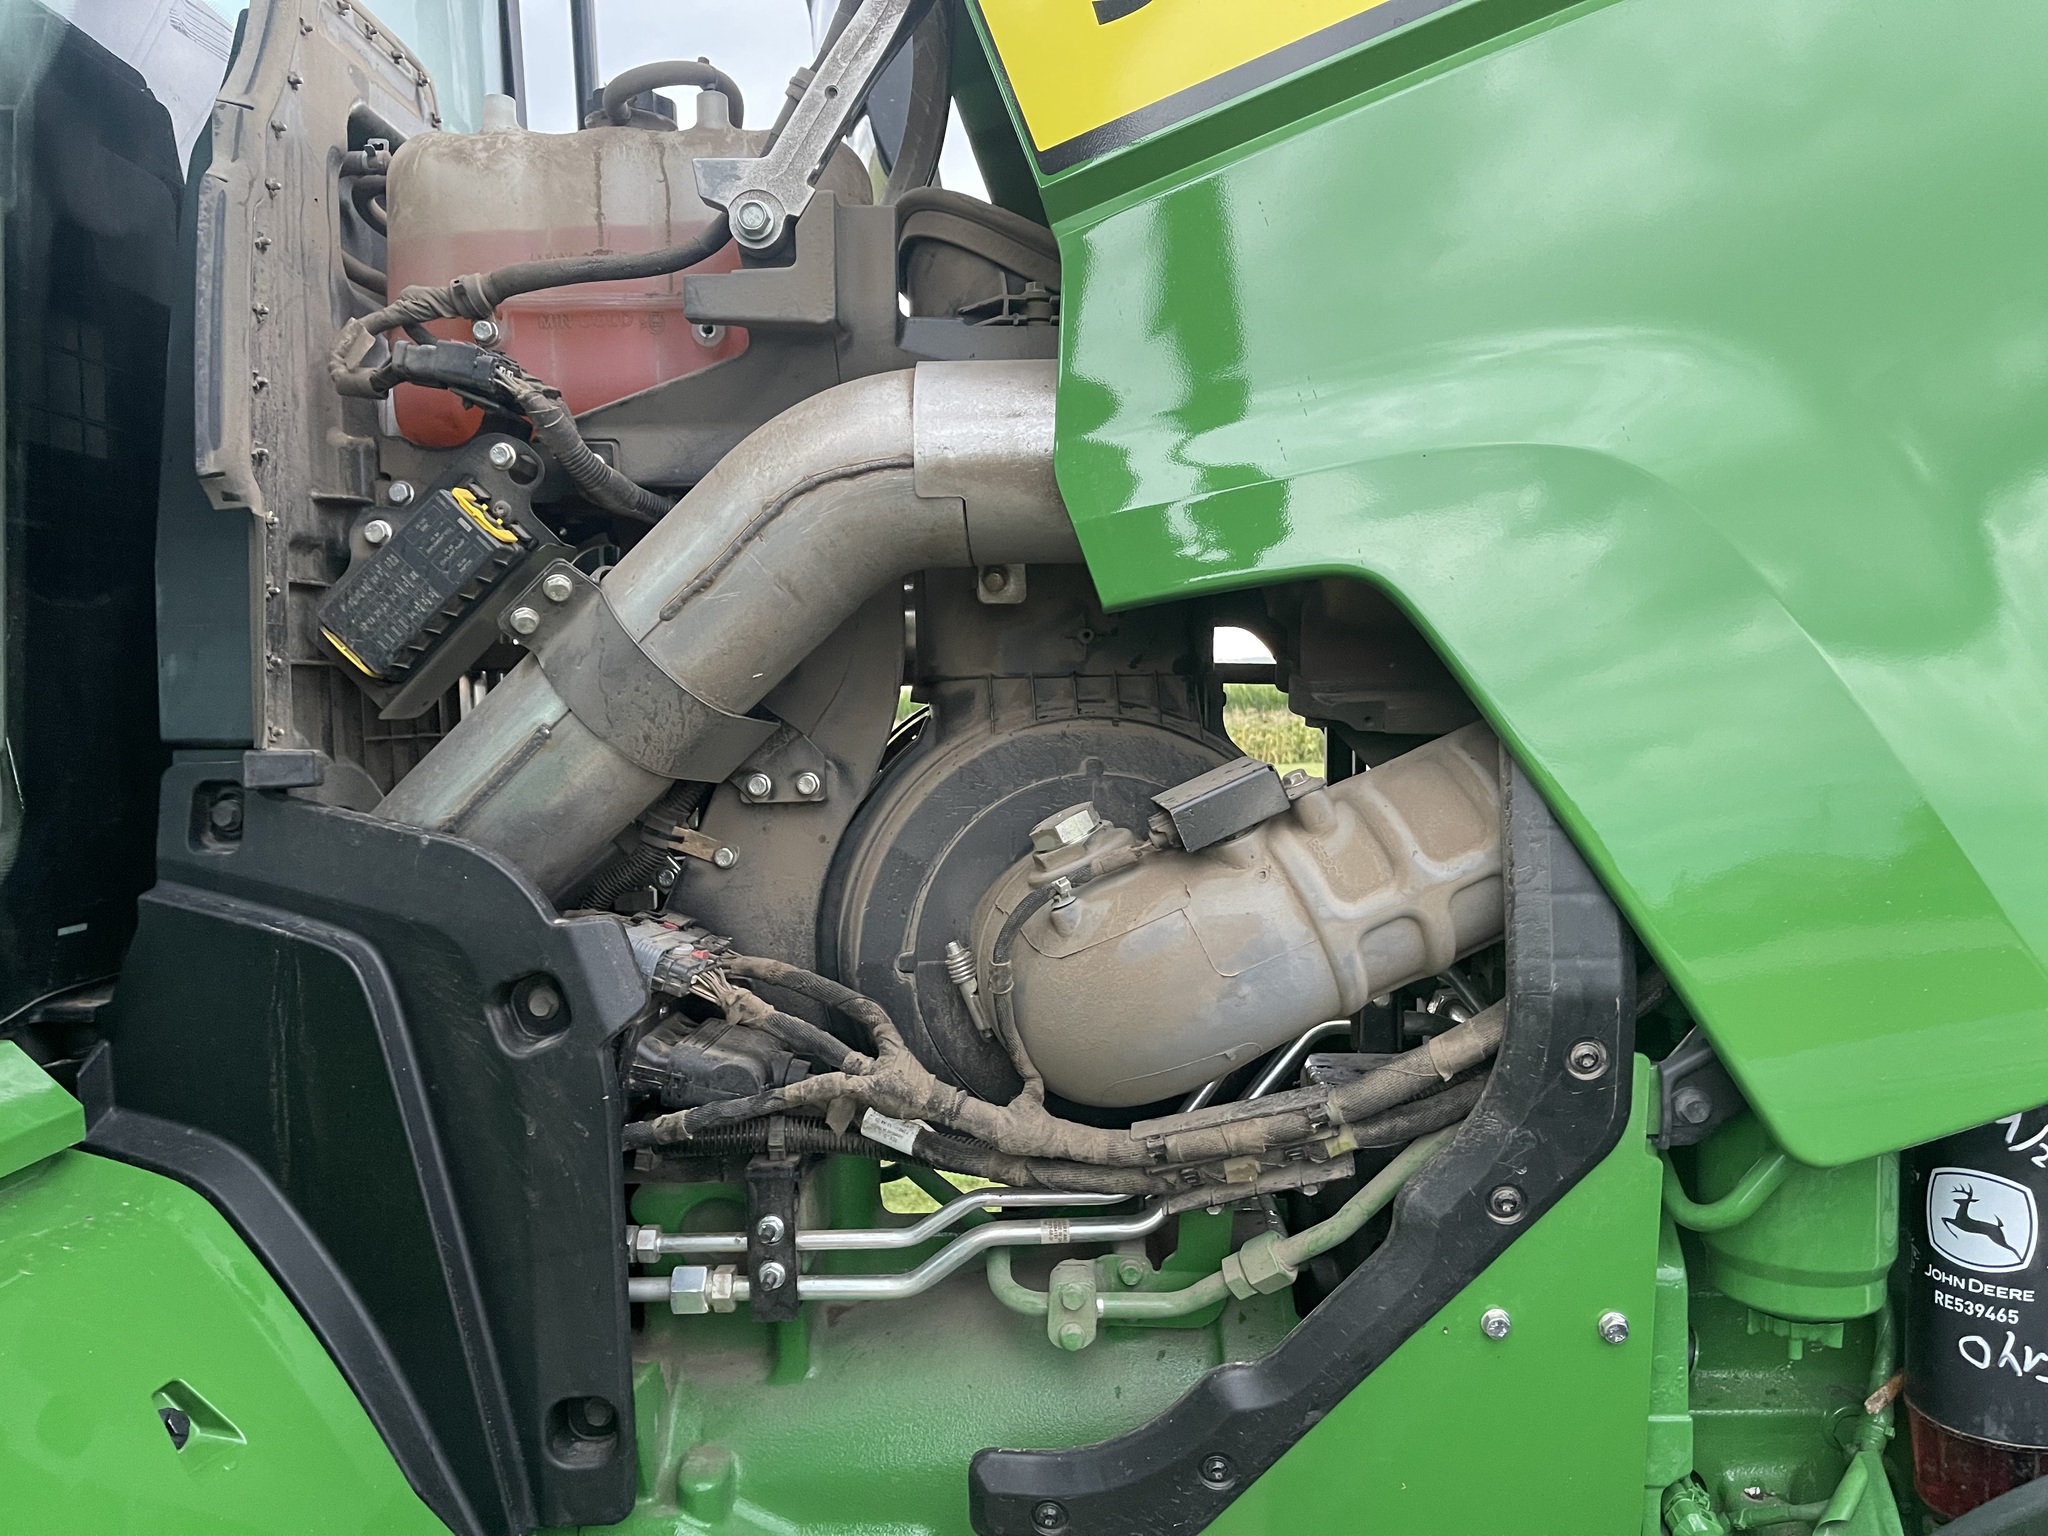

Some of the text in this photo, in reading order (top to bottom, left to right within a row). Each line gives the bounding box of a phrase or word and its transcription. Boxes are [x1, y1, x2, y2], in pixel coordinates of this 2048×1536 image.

[1924, 1263, 2035, 1302] JOHN DEERE
[1934, 1289, 2019, 1325] RE539465
